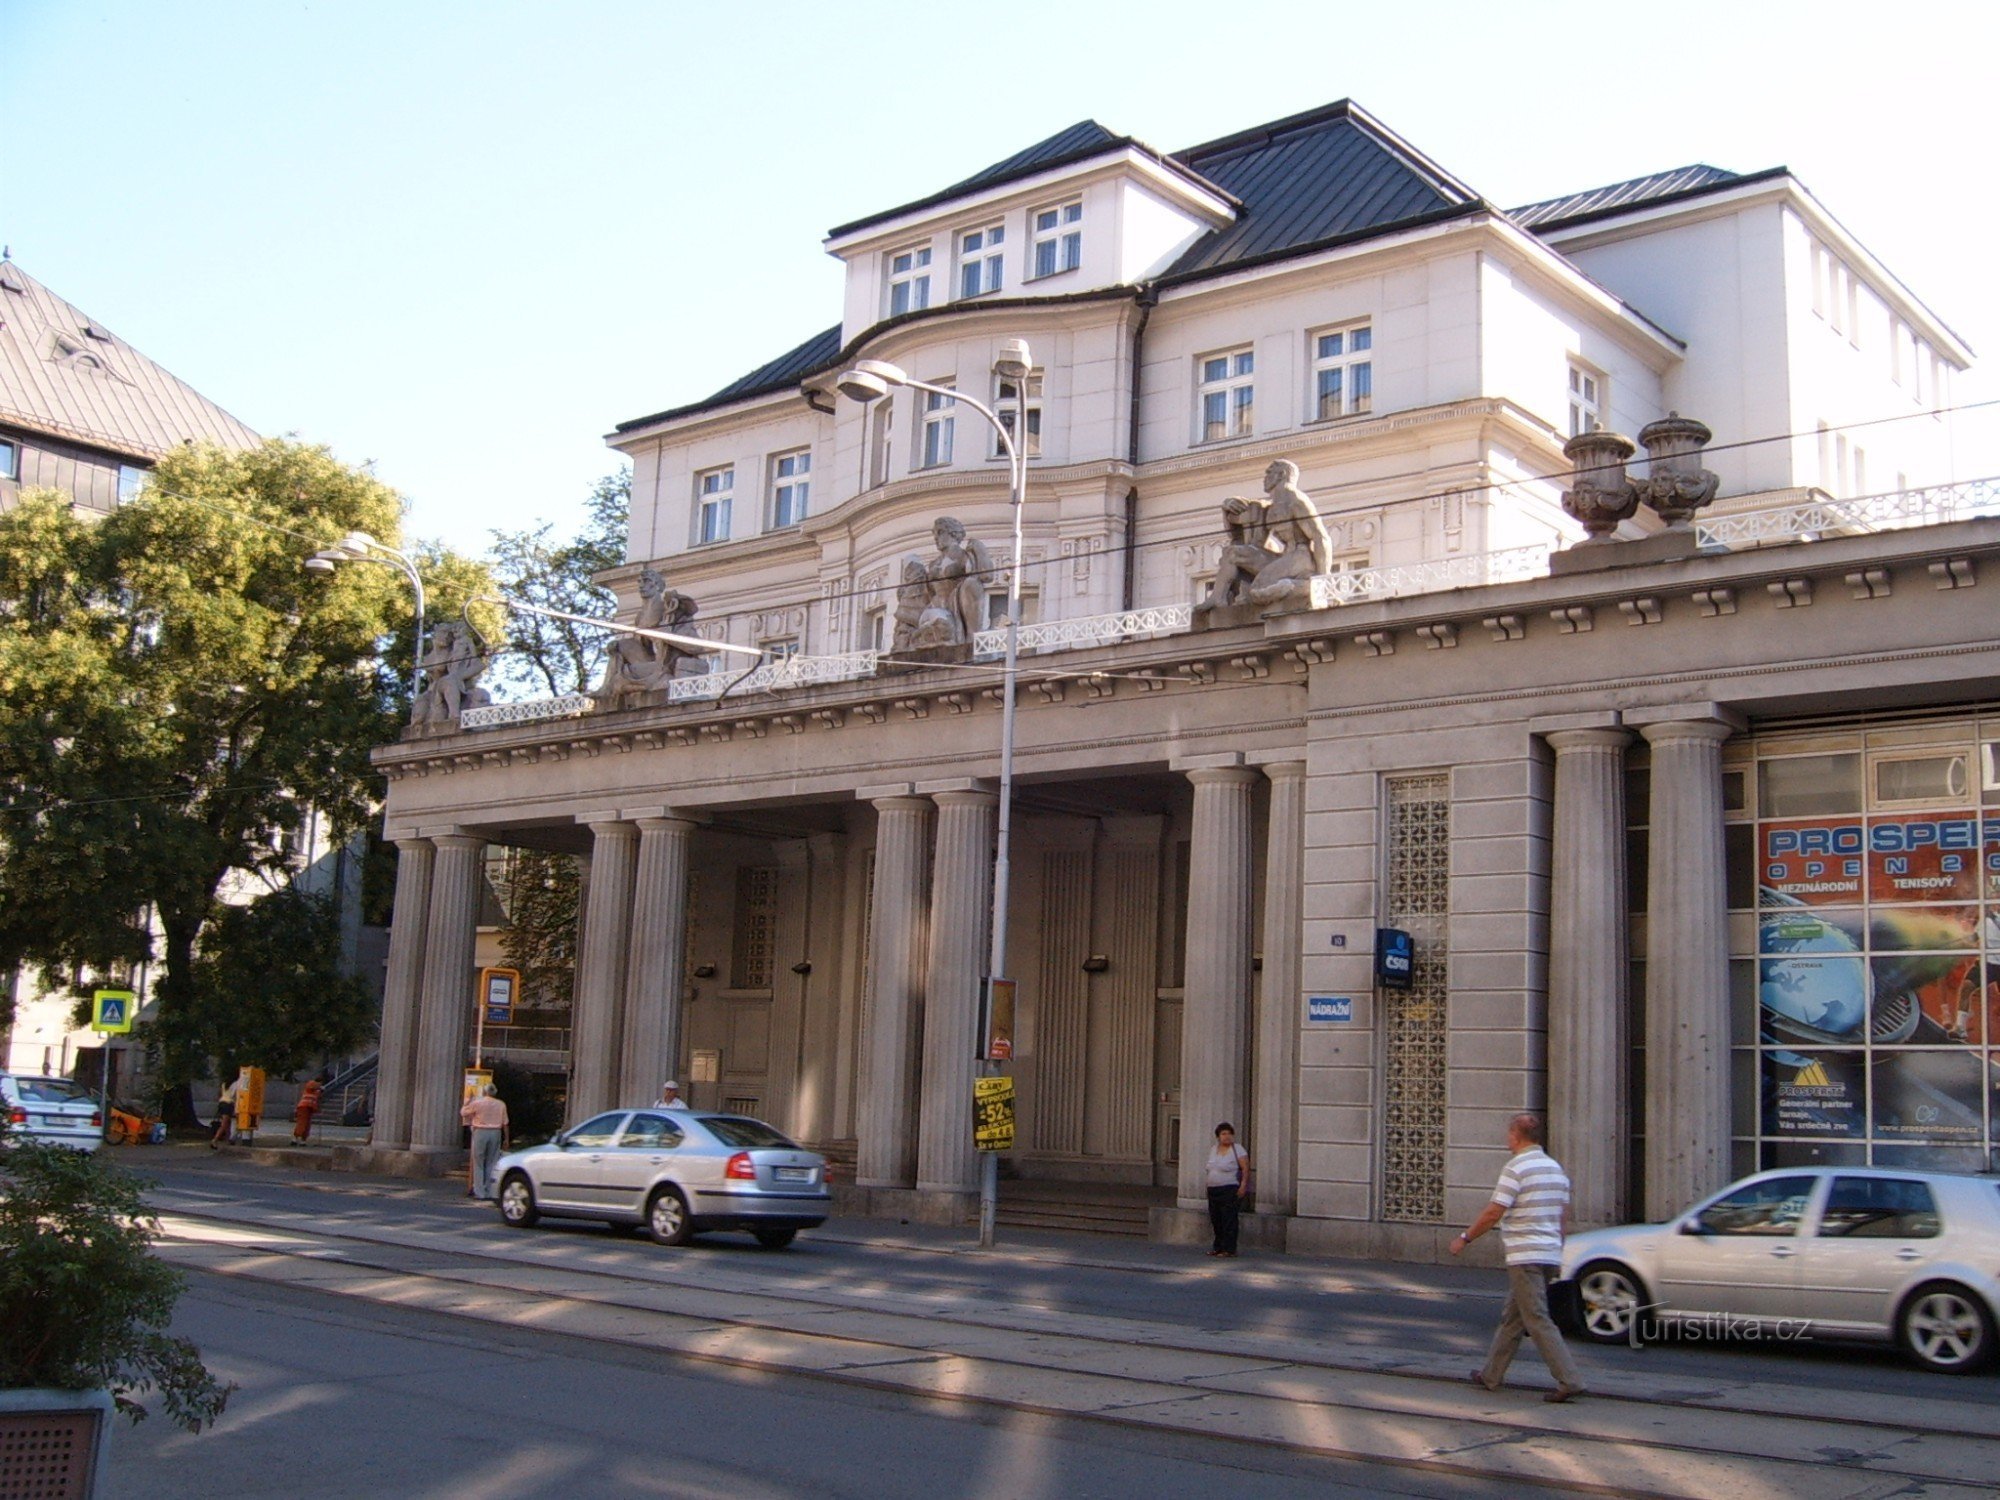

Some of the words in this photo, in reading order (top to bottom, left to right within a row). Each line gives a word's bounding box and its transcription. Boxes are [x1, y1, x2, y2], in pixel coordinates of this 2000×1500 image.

[1767, 857, 1908, 879] OPEN
[1777, 879, 1858, 894] MEZINÁRODNÍ
[1893, 874, 1954, 889] TENISOVÝ
[1310, 1002, 1350, 1015] NÁDRAŽNÍ
[1821, 1100, 1853, 1110] partner
[1778, 1120, 1796, 1129] Vás
[1833, 1123, 1849, 1131] zve
